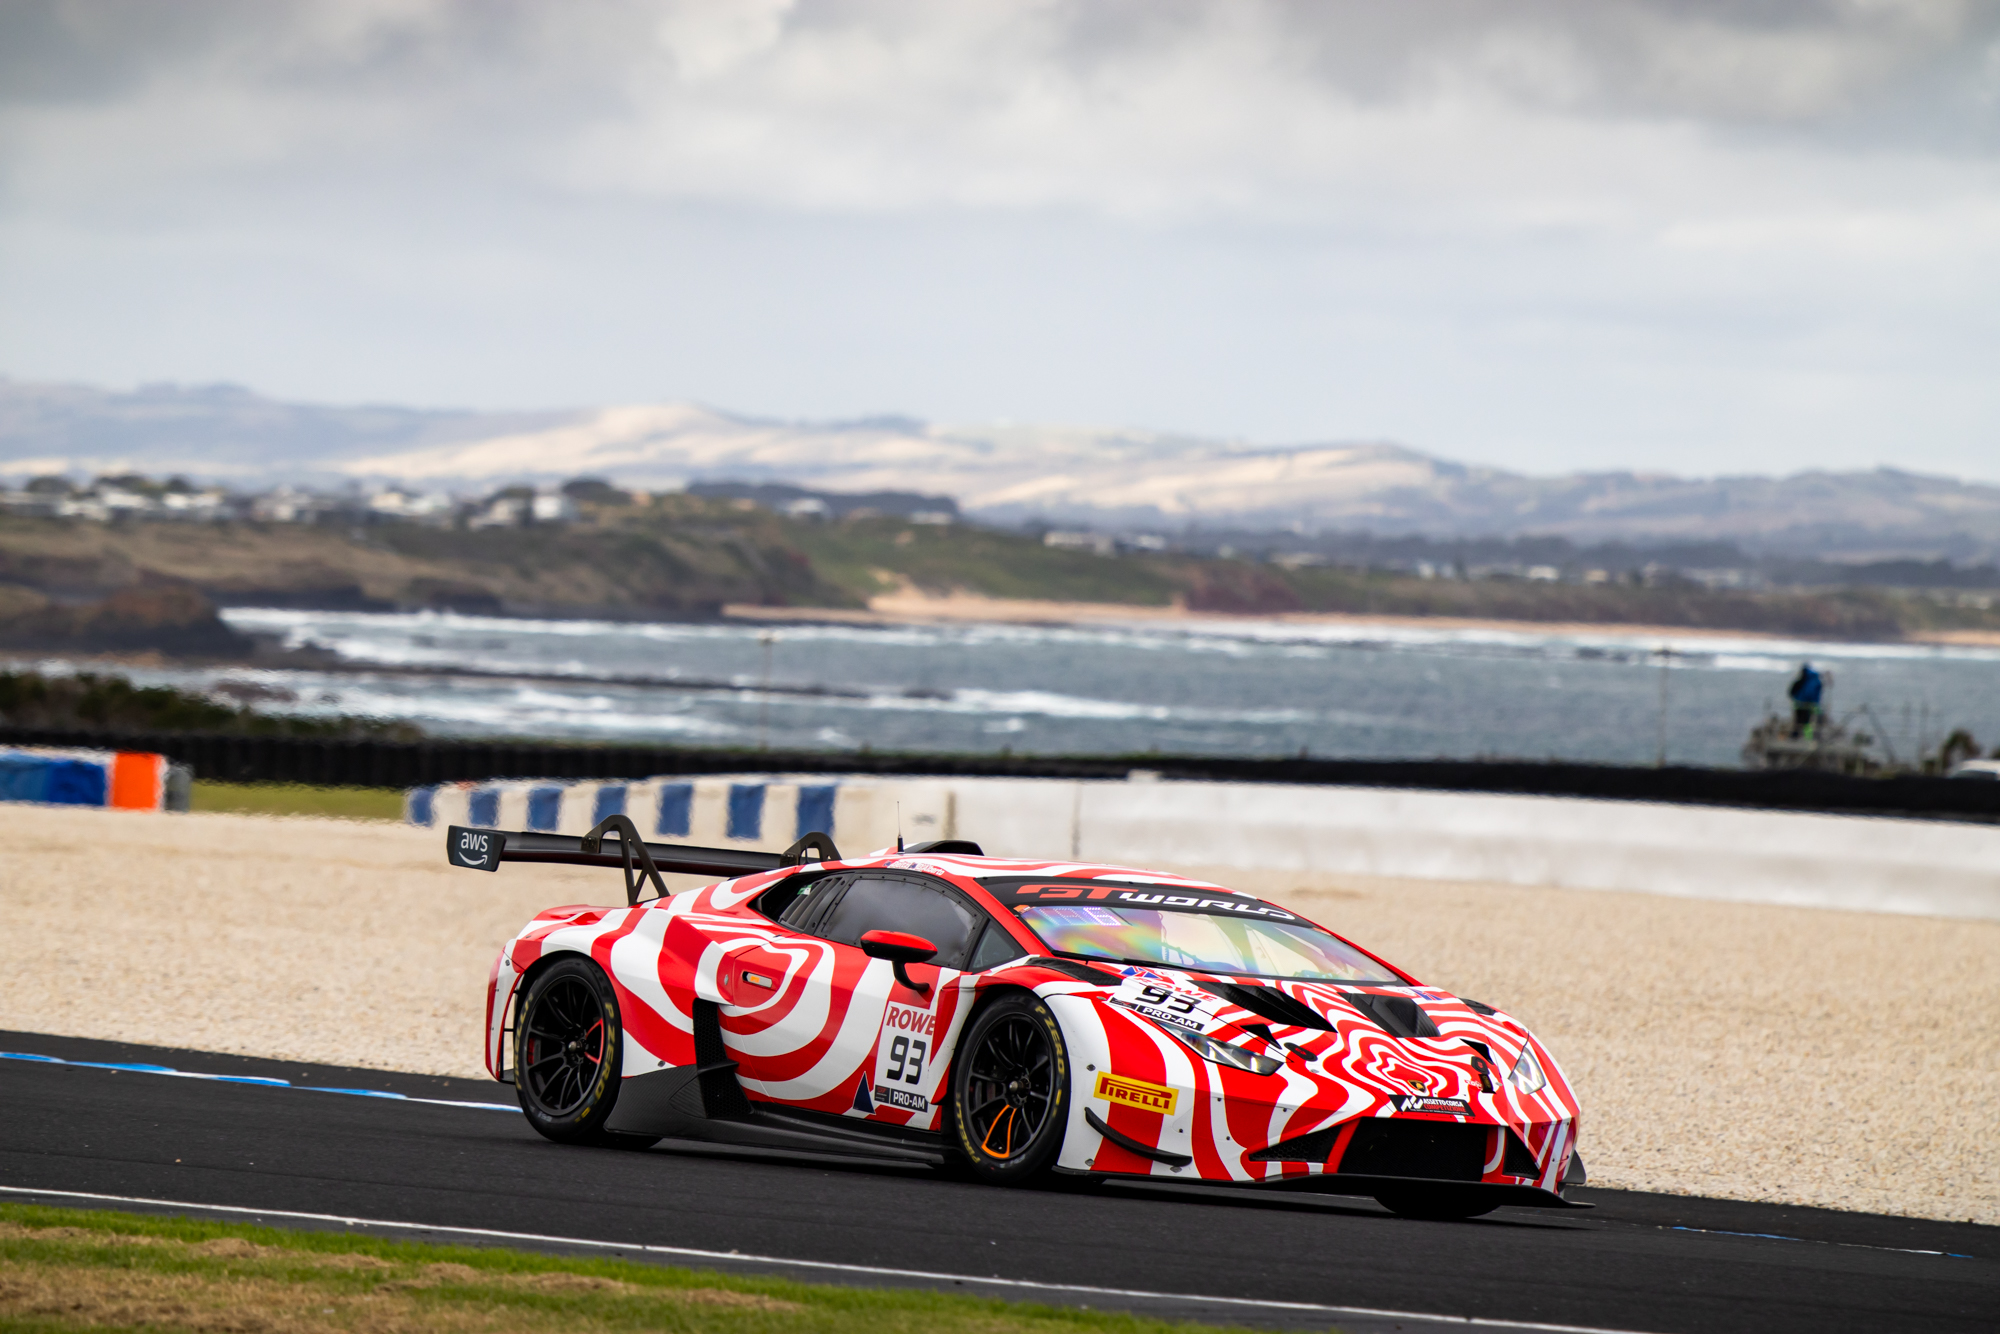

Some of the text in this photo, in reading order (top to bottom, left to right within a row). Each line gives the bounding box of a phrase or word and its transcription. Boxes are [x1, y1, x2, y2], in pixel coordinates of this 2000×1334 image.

[460, 832, 489, 853] aws
[1016, 884, 1296, 921] GT WORLD
[1134, 977, 1218, 1003] ROWE
[1134, 985, 1202, 1015] 93
[886, 1005, 937, 1036] ROWE
[1142, 1007, 1199, 1030] PRO-AM
[886, 1035, 927, 1086] 93
[1044, 1017, 1065, 1076] ZERO
[893, 1090, 926, 1110] PRO-AM
[1099, 1076, 1173, 1110] PIRELLI
